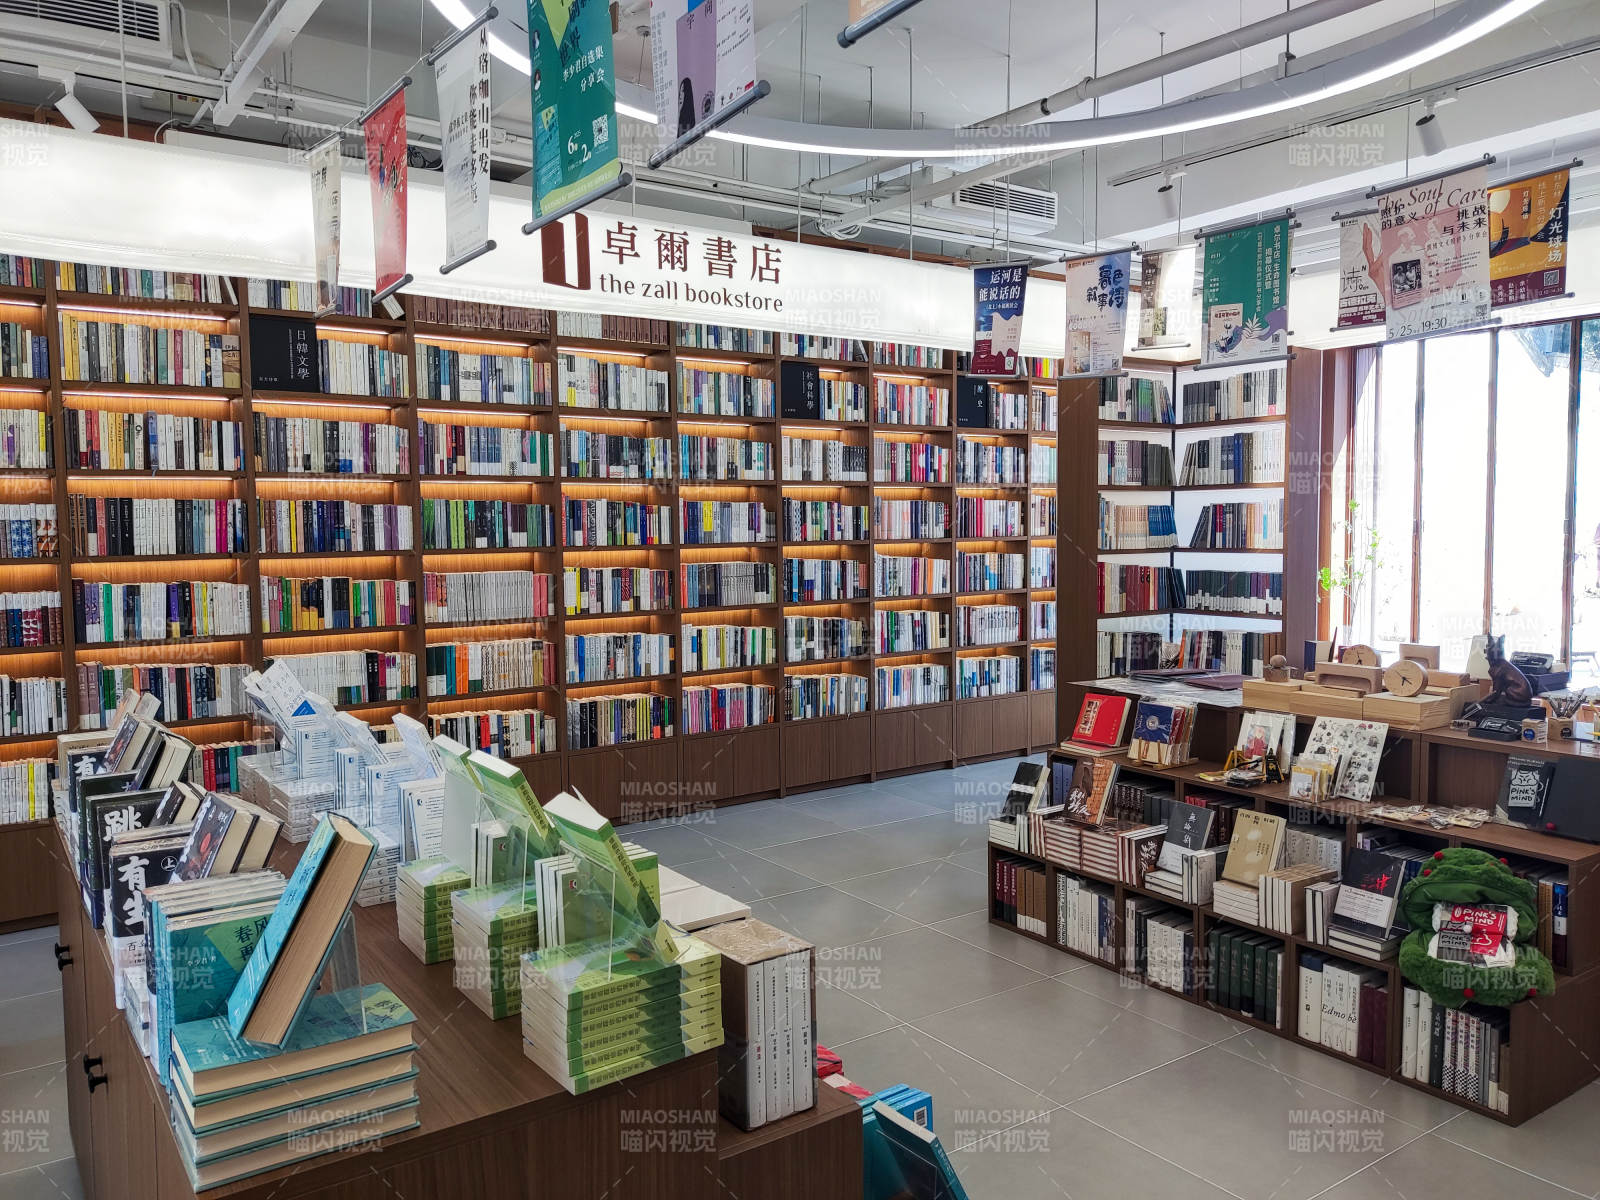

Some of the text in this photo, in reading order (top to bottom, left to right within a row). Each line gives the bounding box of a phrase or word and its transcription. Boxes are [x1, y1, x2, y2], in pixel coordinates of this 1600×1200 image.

[562, 45, 605, 82] 李少君自选集
[580, 67, 605, 93] 分享会
[1457, 204, 1487, 221] 挑战
[1443, 217, 1488, 236] 与未来
[602, 221, 782, 285] 卓爾書店
[990, 267, 1022, 284] 运河是
[600, 273, 783, 312] the zall bookstore
[979, 285, 1021, 302] 能说话的
[1421, 317, 1447, 332] 19:30
[297, 329, 310, 379] 日韓文學
[164, 857, 176, 869] 上
